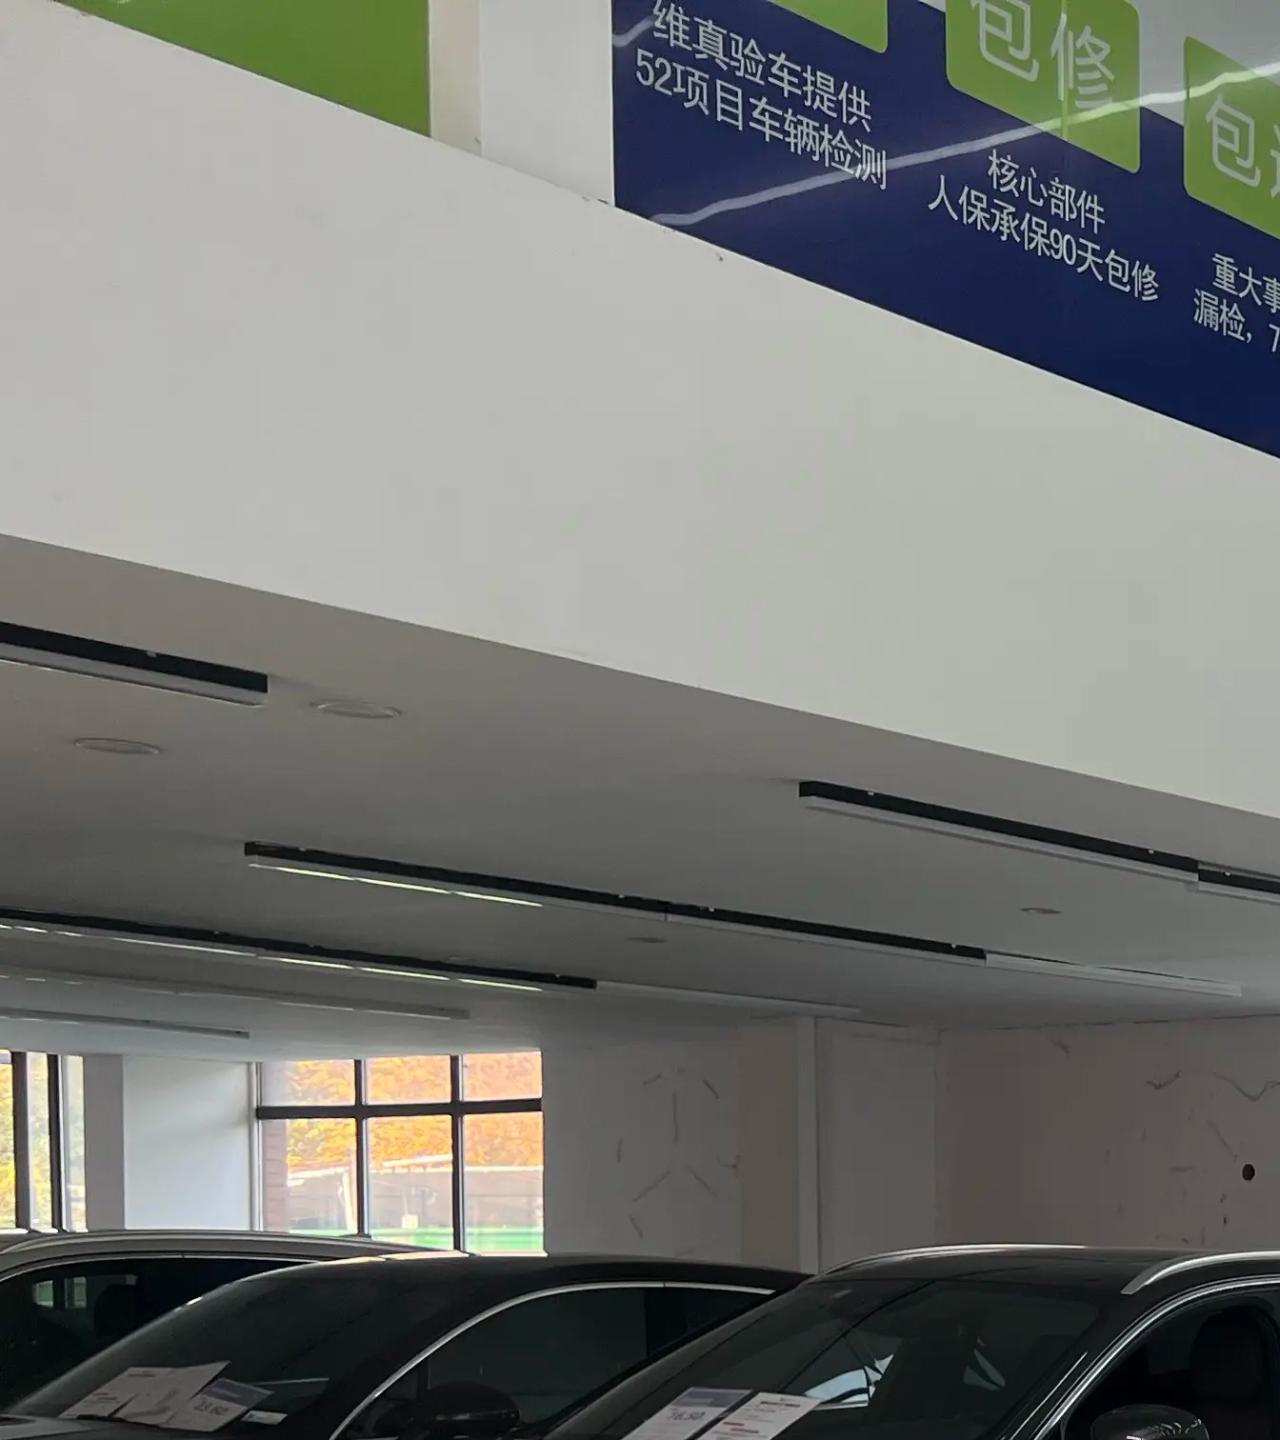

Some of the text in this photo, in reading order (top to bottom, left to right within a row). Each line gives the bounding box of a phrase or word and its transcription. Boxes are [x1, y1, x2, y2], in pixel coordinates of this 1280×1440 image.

[653, 0, 872, 132] 维真验车提供
[970, 0, 1115, 109] 包修
[634, 48, 887, 190] 52项目车辆检测
[928, 174, 1159, 302] 人保承保90天包修
[988, 149, 1106, 235] 核心部件
